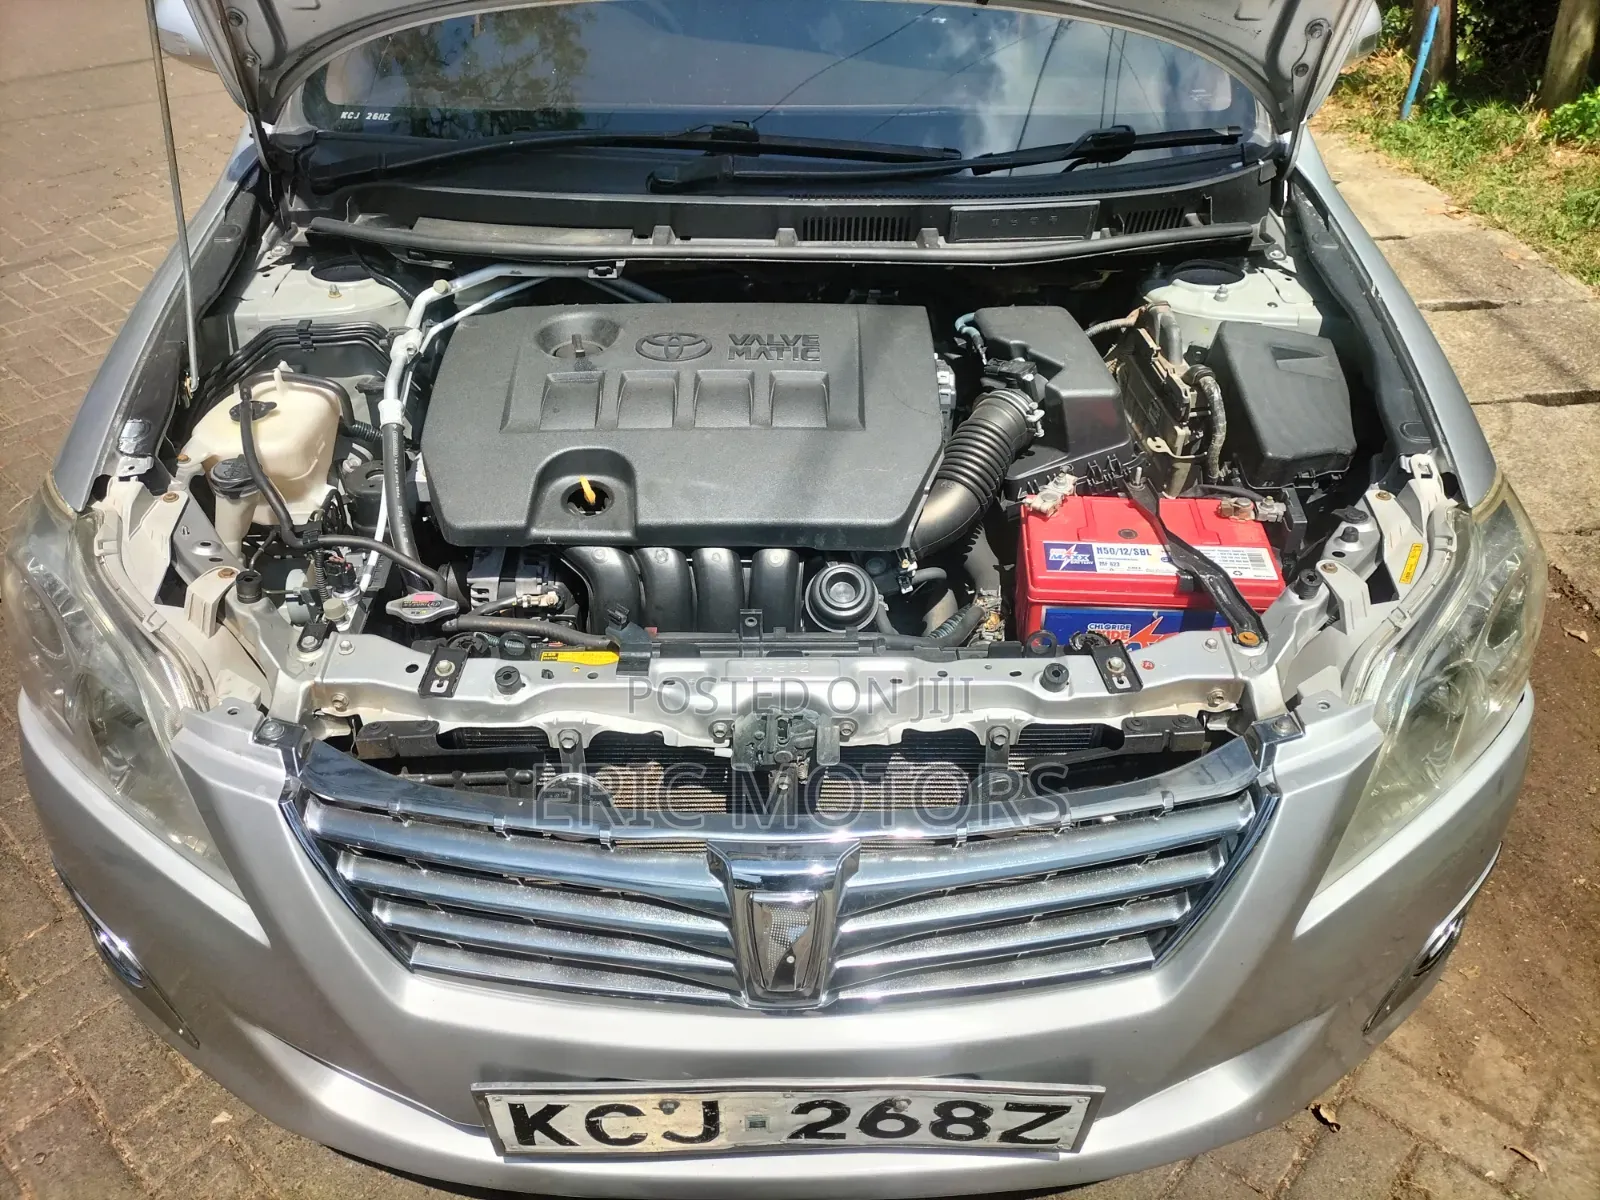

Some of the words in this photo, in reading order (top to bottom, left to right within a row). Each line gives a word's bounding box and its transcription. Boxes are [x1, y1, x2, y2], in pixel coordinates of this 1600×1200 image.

[340, 111, 360, 119] KCJ
[728, 333, 820, 347] VALVE
[727, 346, 821, 361] MATIC
[1096, 546, 1152, 556] N50/12/SBL
[507, 1101, 721, 1147] KCJ
[790, 1099, 1072, 1145] 268Z
